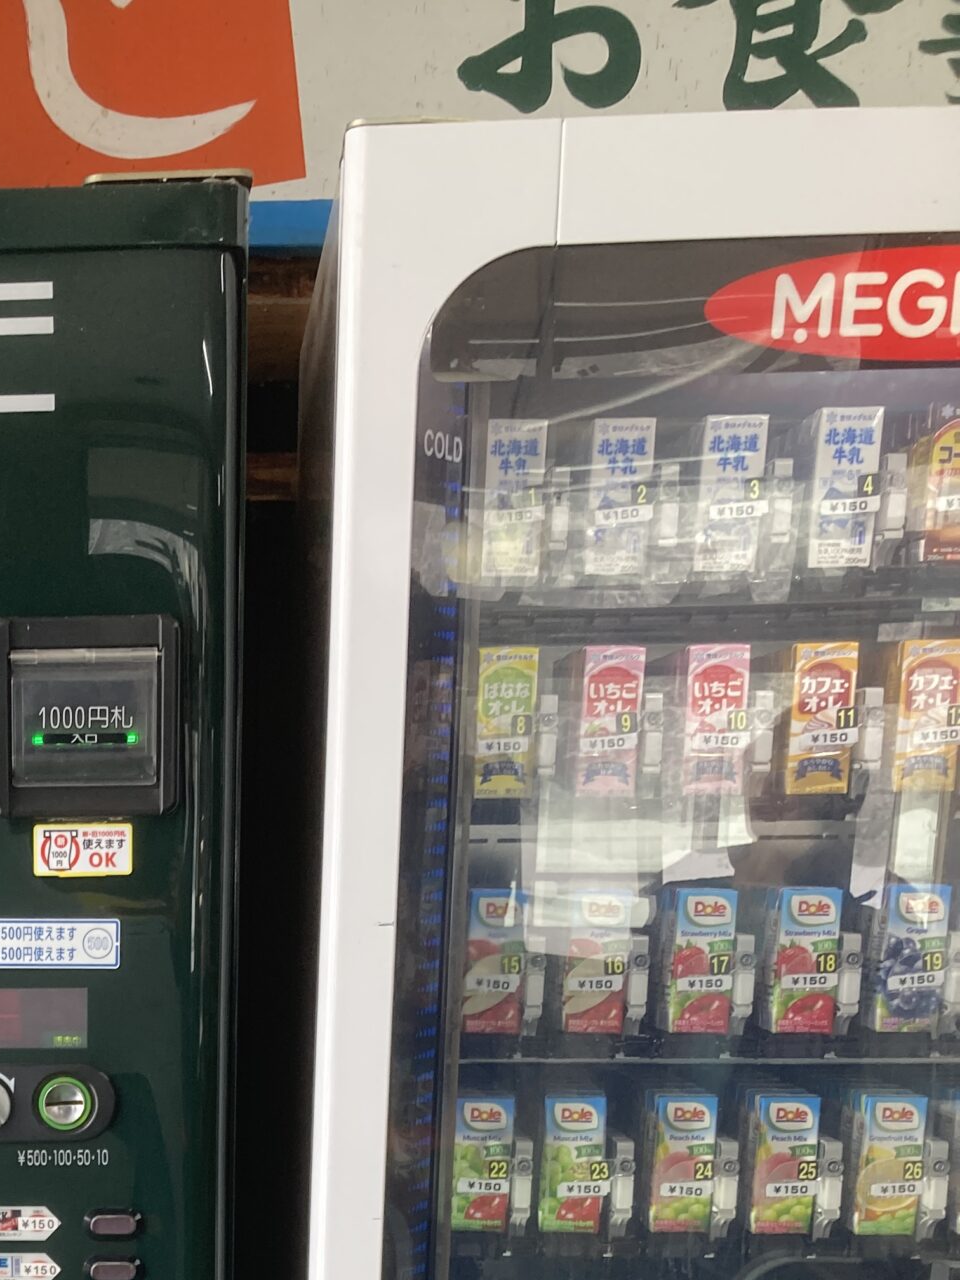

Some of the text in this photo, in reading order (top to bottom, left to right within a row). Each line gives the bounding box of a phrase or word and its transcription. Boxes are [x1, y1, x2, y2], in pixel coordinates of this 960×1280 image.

[771, 267, 960, 344] MEG
[709, 433, 760, 453] 北海道
[824, 427, 875, 446] 北海道
[424, 429, 463, 463] COLD
[597, 438, 648, 457] 北海道
[832, 447, 864, 465] 牛乳
[750, 480, 759, 499] 3
[863, 475, 873, 495] 4
[637, 485, 647, 504] 2
[829, 501, 868, 512] ¥150
[590, 681, 638, 699] いちご
[694, 677, 744, 697] いちご
[38, 706, 134, 730] 1000円札
[517, 715, 526, 734] 8
[621, 714, 631, 732] 9
[728, 711, 746, 731] 10
[838, 709, 856, 728] 11
[70, 733, 98, 745] 入口
[703, 735, 739, 746] ¥150
[811, 732, 848, 743] ¥150
[920, 730, 959, 741] ¥150
[485, 741, 521, 752] ¥150
[589, 738, 625, 749] ¥150
[83, 838, 127, 850] 使えます
[52, 850, 67, 858] 1000
[89, 852, 117, 868] OK
[694, 900, 727, 915] Dole
[797, 899, 830, 914] Dole
[502, 957, 520, 974] 15
[606, 957, 624, 974] 16
[711, 955, 729, 973] 17
[818, 953, 836, 972] 18
[924, 953, 941, 971] 19
[475, 979, 510, 991] ¥150
[578, 979, 613, 989] ¥150
[688, 979, 723, 988] ¥150
[792, 976, 827, 986] ¥150
[899, 974, 935, 985] ¥150
[470, 1107, 501, 1121] Dole
[561, 1107, 593, 1121] Dole
[673, 1107, 705, 1120] Dole
[776, 1107, 807, 1120] Dole
[882, 1107, 914, 1120] Dole
[490, 1161, 507, 1178] 22
[592, 1163, 609, 1180] 23
[695, 1162, 712, 1180] 24
[799, 1162, 817, 1180] 25
[905, 1162, 922, 1180] 26
[468, 1181, 501, 1192] ¥150
[567, 1184, 600, 1194] ¥150
[669, 1185, 703, 1197] ¥150
[774, 1185, 808, 1194] ¥150
[881, 1184, 916, 1194] ¥150
[21, 1219, 55, 1230] ¥150
[24, 1265, 57, 1276] ¥150
